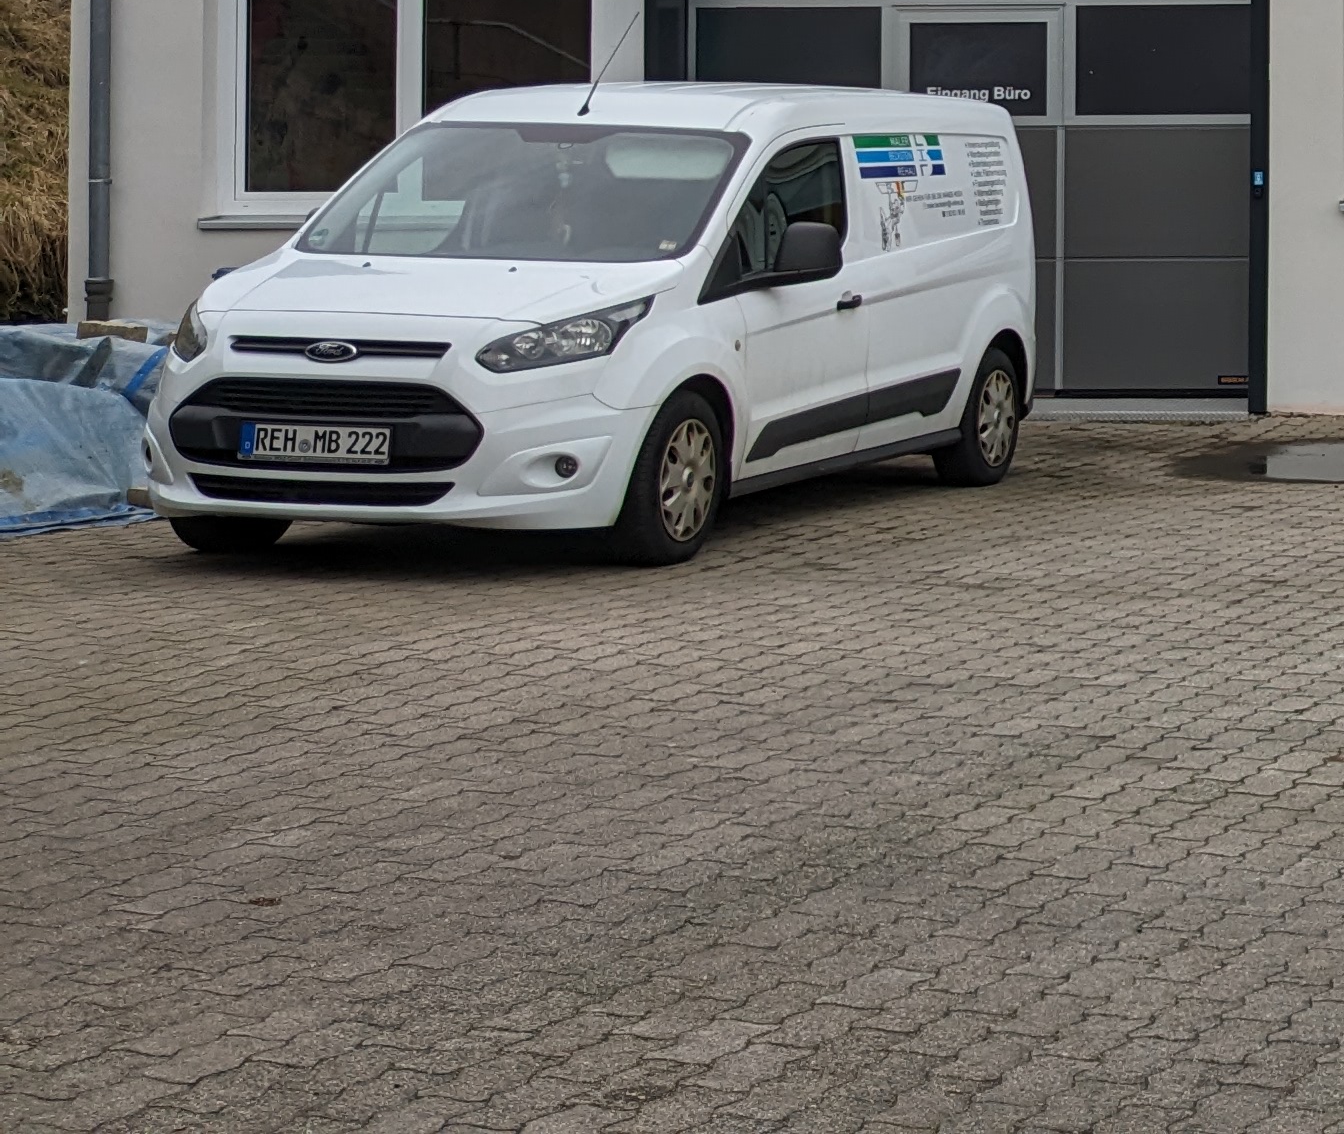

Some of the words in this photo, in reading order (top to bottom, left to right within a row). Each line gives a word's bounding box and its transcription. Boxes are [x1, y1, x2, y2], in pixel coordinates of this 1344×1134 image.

[993, 86, 1031, 100] Büro
[244, 441, 251, 449] D
[255, 427, 297, 452] REH
[312, 429, 341, 454] MB
[345, 430, 388, 455] 222
